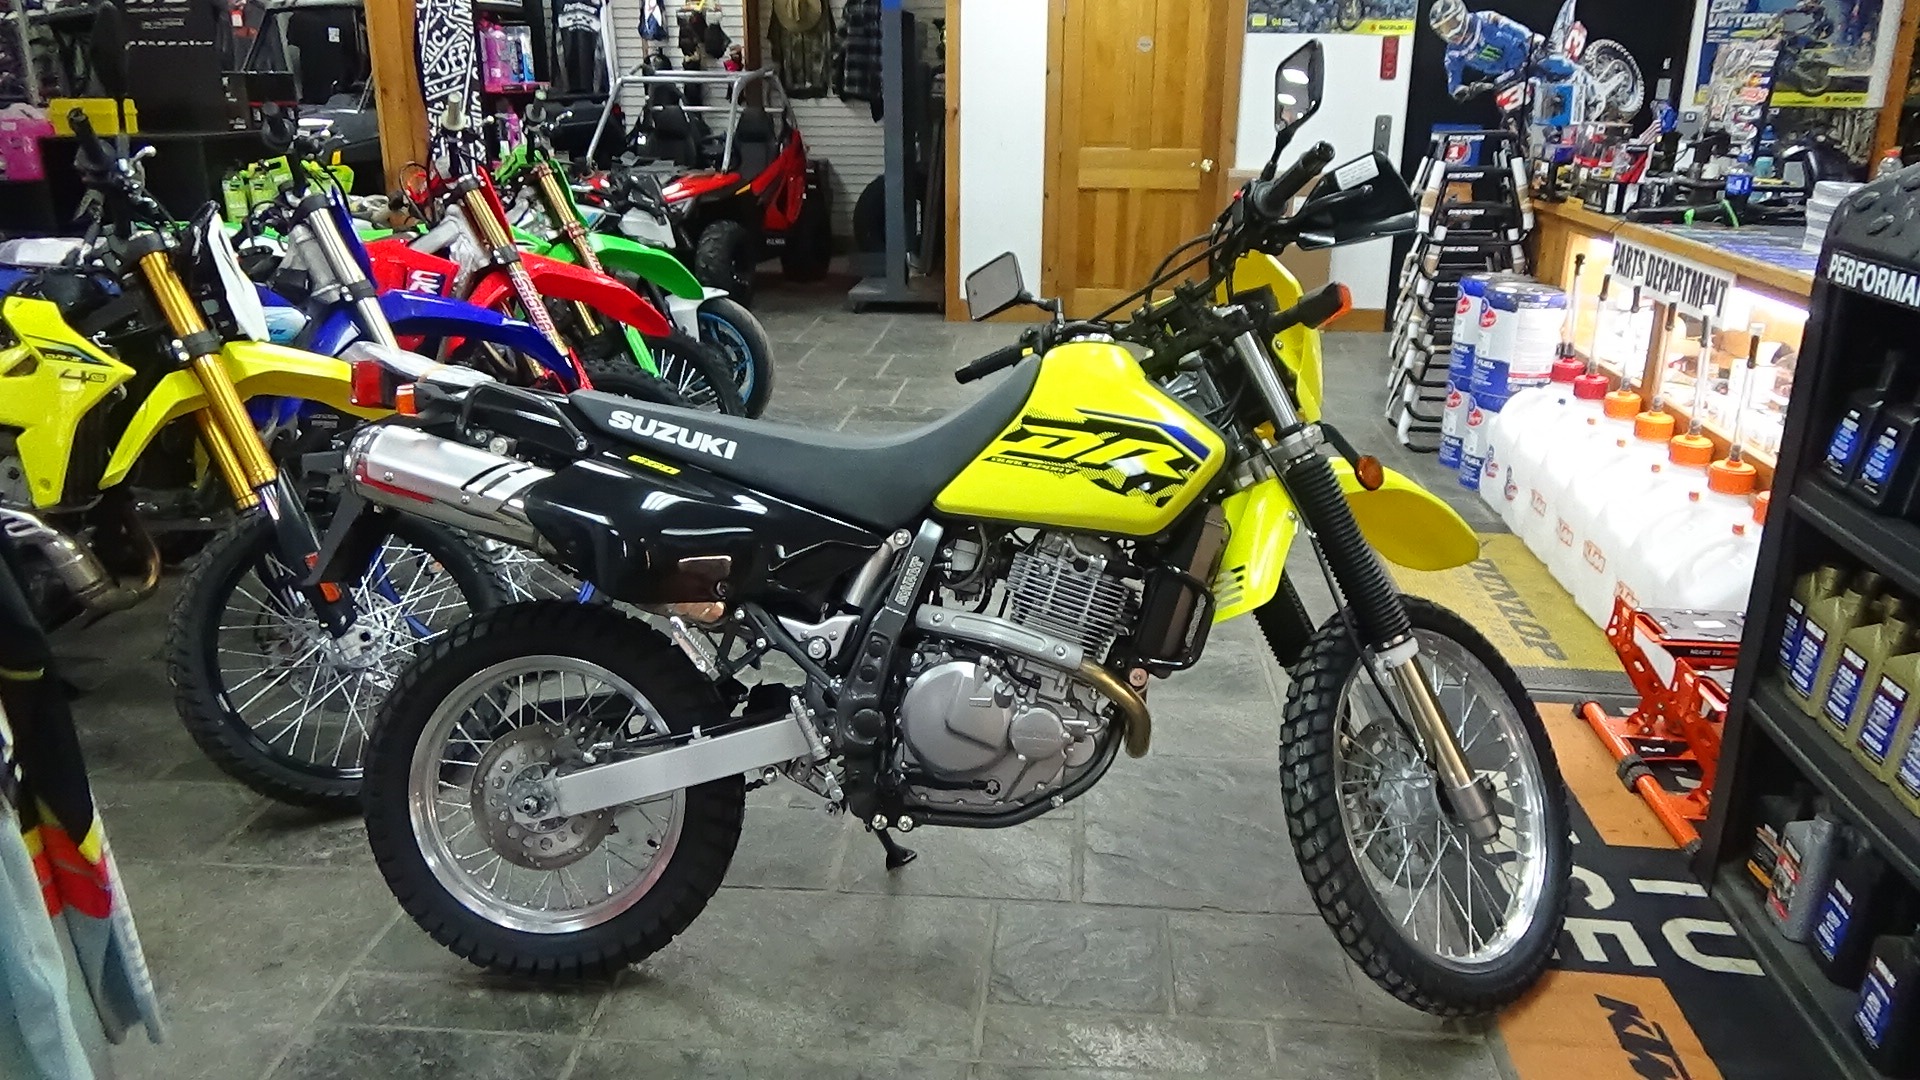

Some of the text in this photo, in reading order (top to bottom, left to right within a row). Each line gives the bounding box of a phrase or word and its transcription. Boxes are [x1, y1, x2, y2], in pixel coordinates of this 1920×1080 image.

[1612, 241, 1729, 318] PARTS DEPARTMENT
[1827, 254, 1920, 307] PERFORMA
[608, 410, 738, 460] SUZUKI
[1468, 558, 1568, 661] UNLOP
